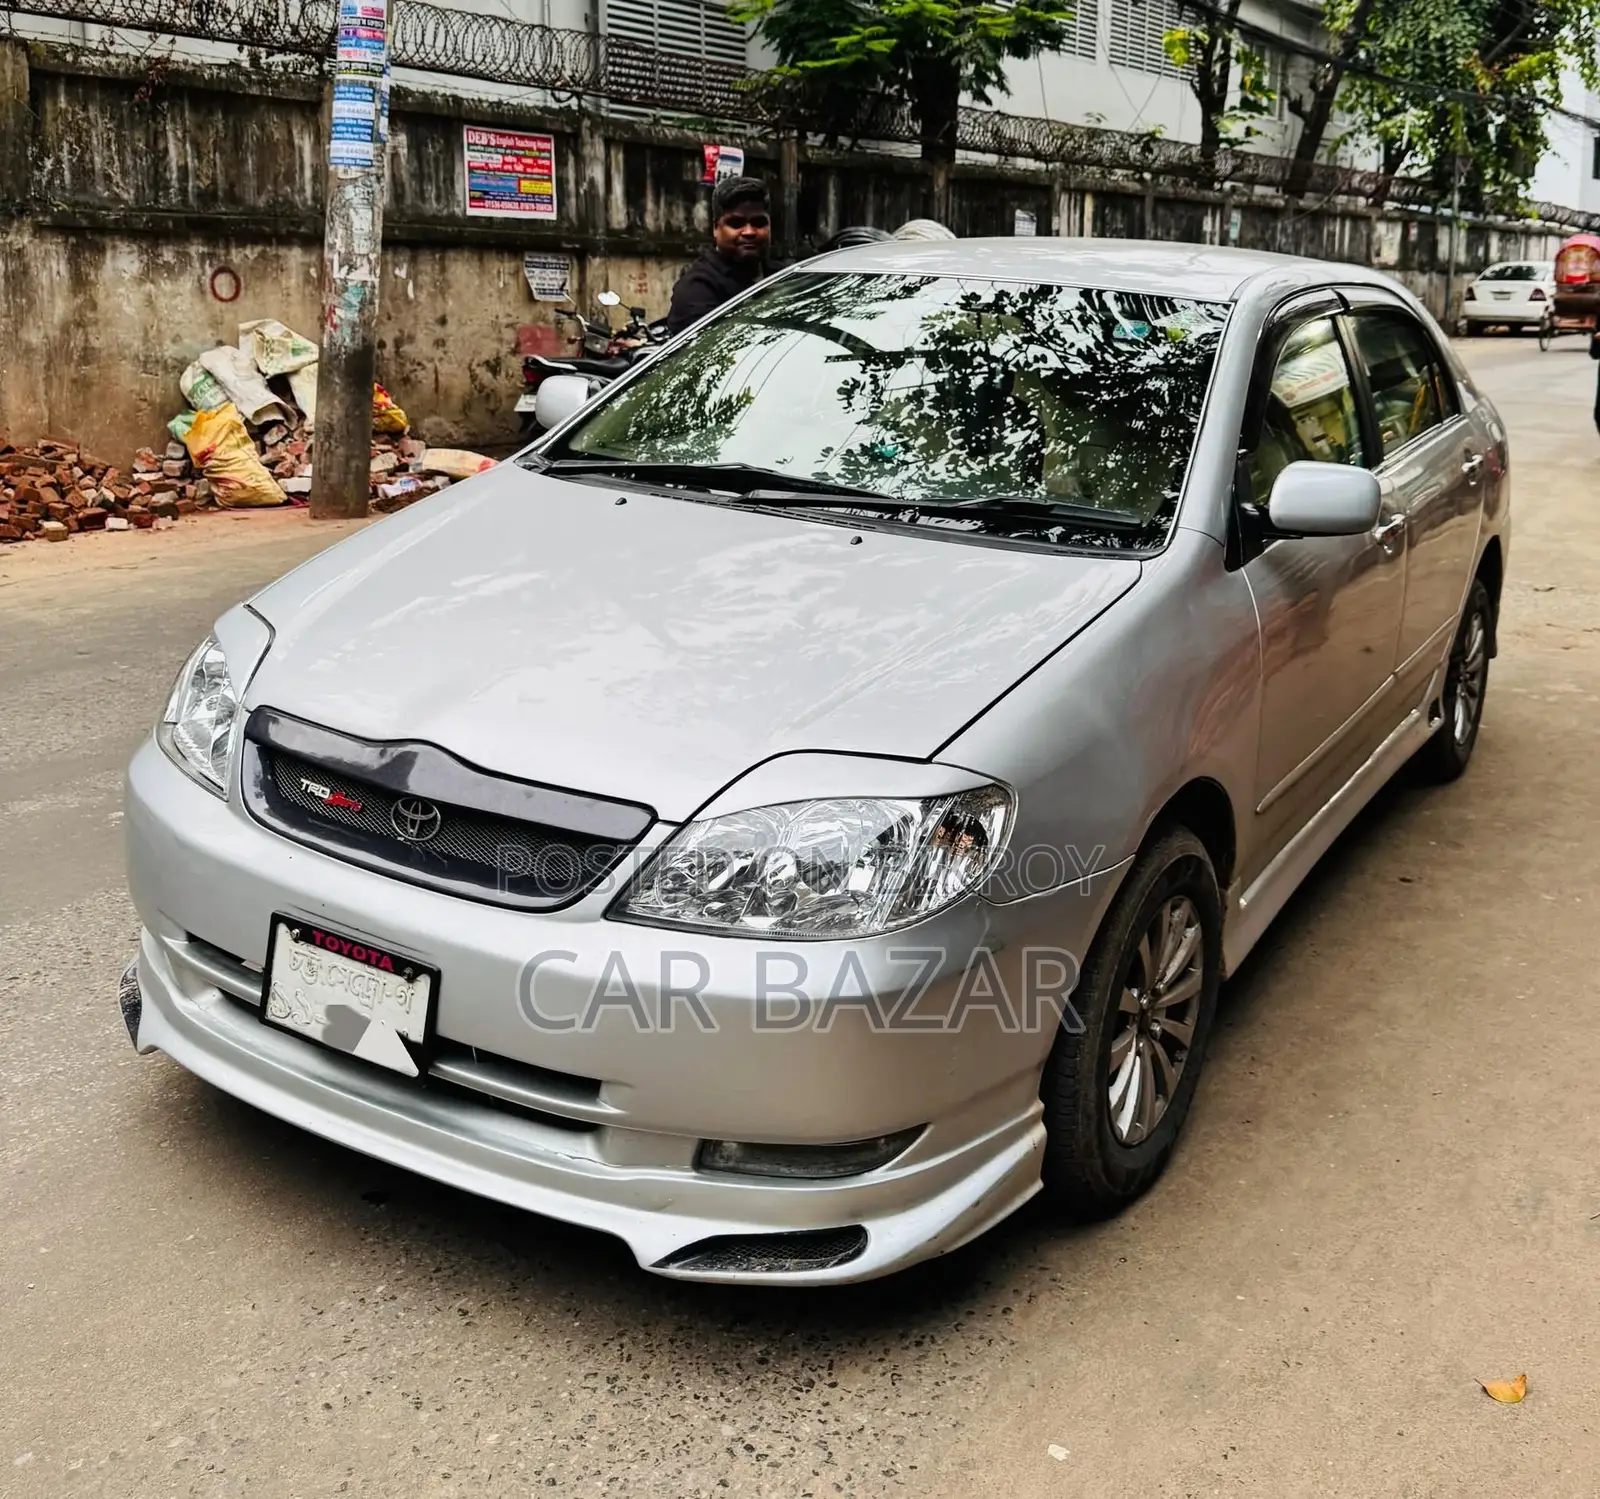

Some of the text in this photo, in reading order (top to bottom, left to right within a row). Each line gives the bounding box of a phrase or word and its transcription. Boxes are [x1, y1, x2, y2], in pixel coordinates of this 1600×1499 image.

[467, 130, 496, 146] DEB'S
[300, 778, 330, 799] TRD
[311, 929, 395, 973] TOYOTA
